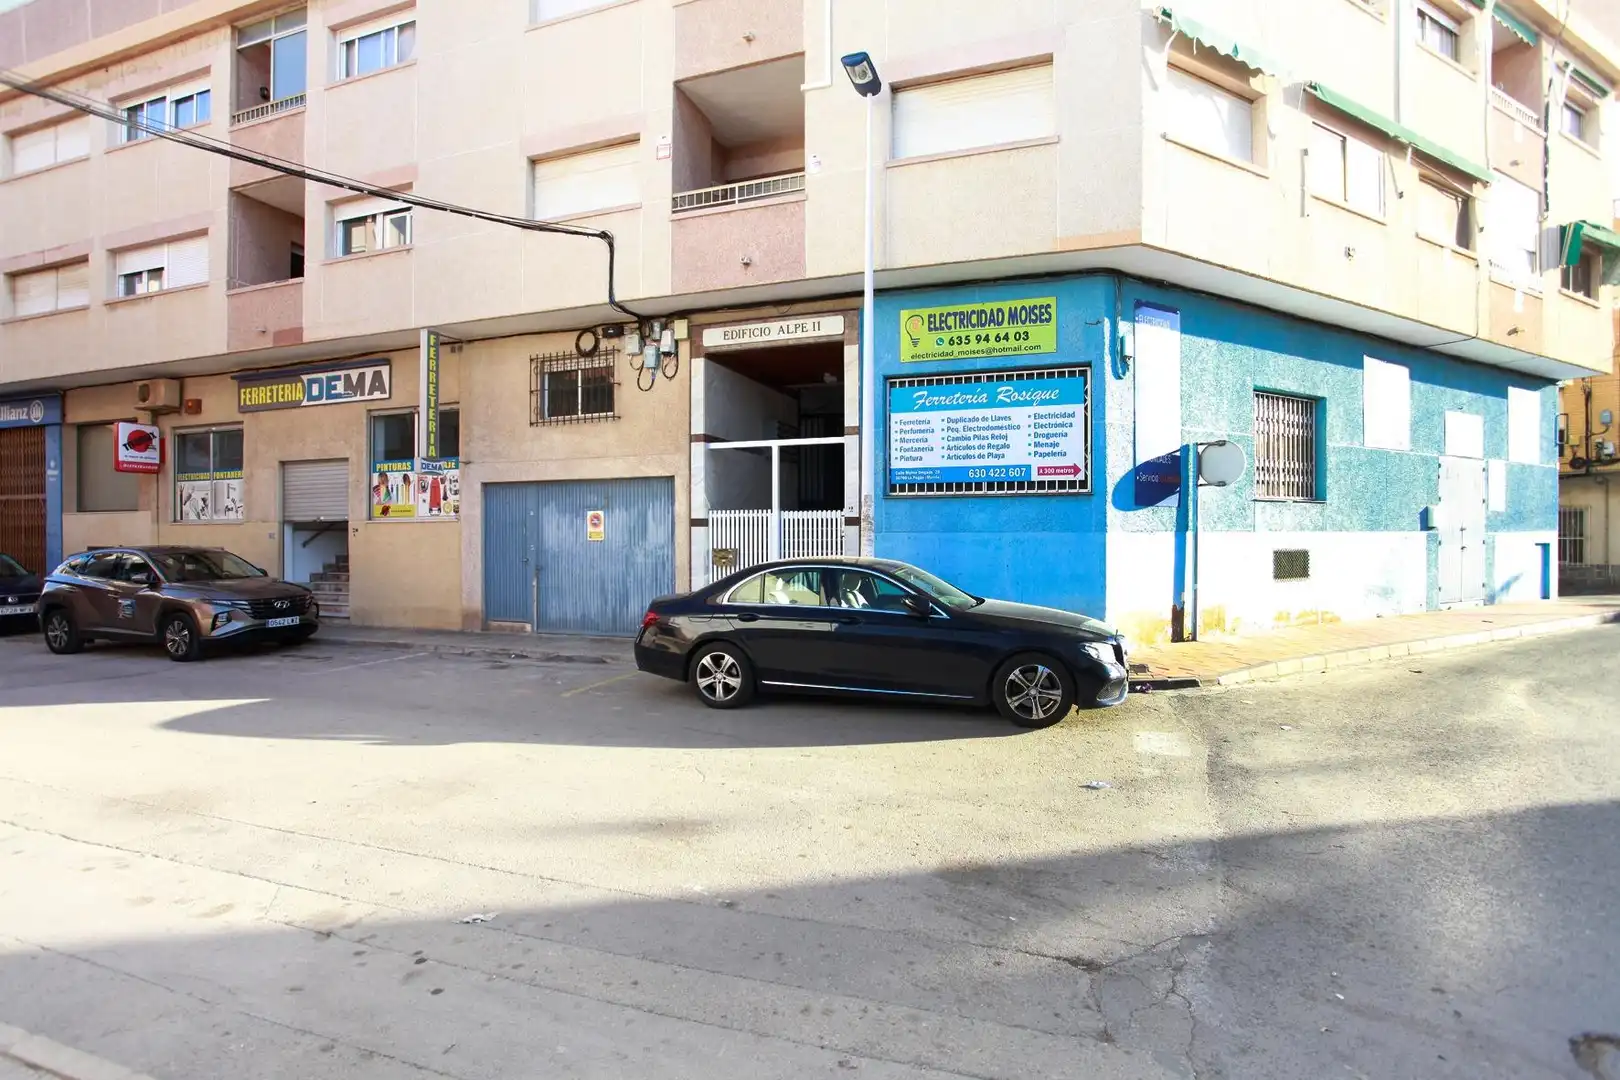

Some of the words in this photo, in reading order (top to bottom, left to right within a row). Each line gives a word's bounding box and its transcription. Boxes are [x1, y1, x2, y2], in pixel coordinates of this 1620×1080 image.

[926, 306, 1005, 332] ELECTRICIDAD
[1008, 303, 1052, 326] MOISES
[723, 326, 771, 340] EDIFICIO
[777, 322, 808, 335] ALPE
[948, 334, 971, 346] 635
[975, 333, 991, 345] 94
[994, 332, 1010, 343] 64
[1013, 331, 1030, 342] 03
[911, 344, 1042, 360] electricidad_moises@hotmail.com
[240, 381, 304, 406] FERRETERIA
[306, 369, 387, 402] DEMA
[428, 334, 437, 457] FERRETERIA
[913, 388, 988, 410] Ferretería
[996, 386, 1060, 406] Rosique
[946, 416, 980, 425] Duplicado
[990, 414, 1012, 422] Llaves
[1033, 411, 1076, 420] Electricidad
[1033, 421, 1073, 429] Electrónica
[946, 434, 971, 442] Cambio
[972, 433, 989, 441] Pilas
[990, 432, 1008, 441] Reloj
[986, 442, 1010, 451] Regalo
[1033, 441, 1060, 449] Menaje
[987, 451, 1005, 461] Playa
[376, 461, 412, 472] PINTURAS
[421, 462, 443, 472] DEMA
[968, 469, 986, 478] 630
[988, 468, 1006, 477] 422
[1008, 467, 1026, 476] 607
